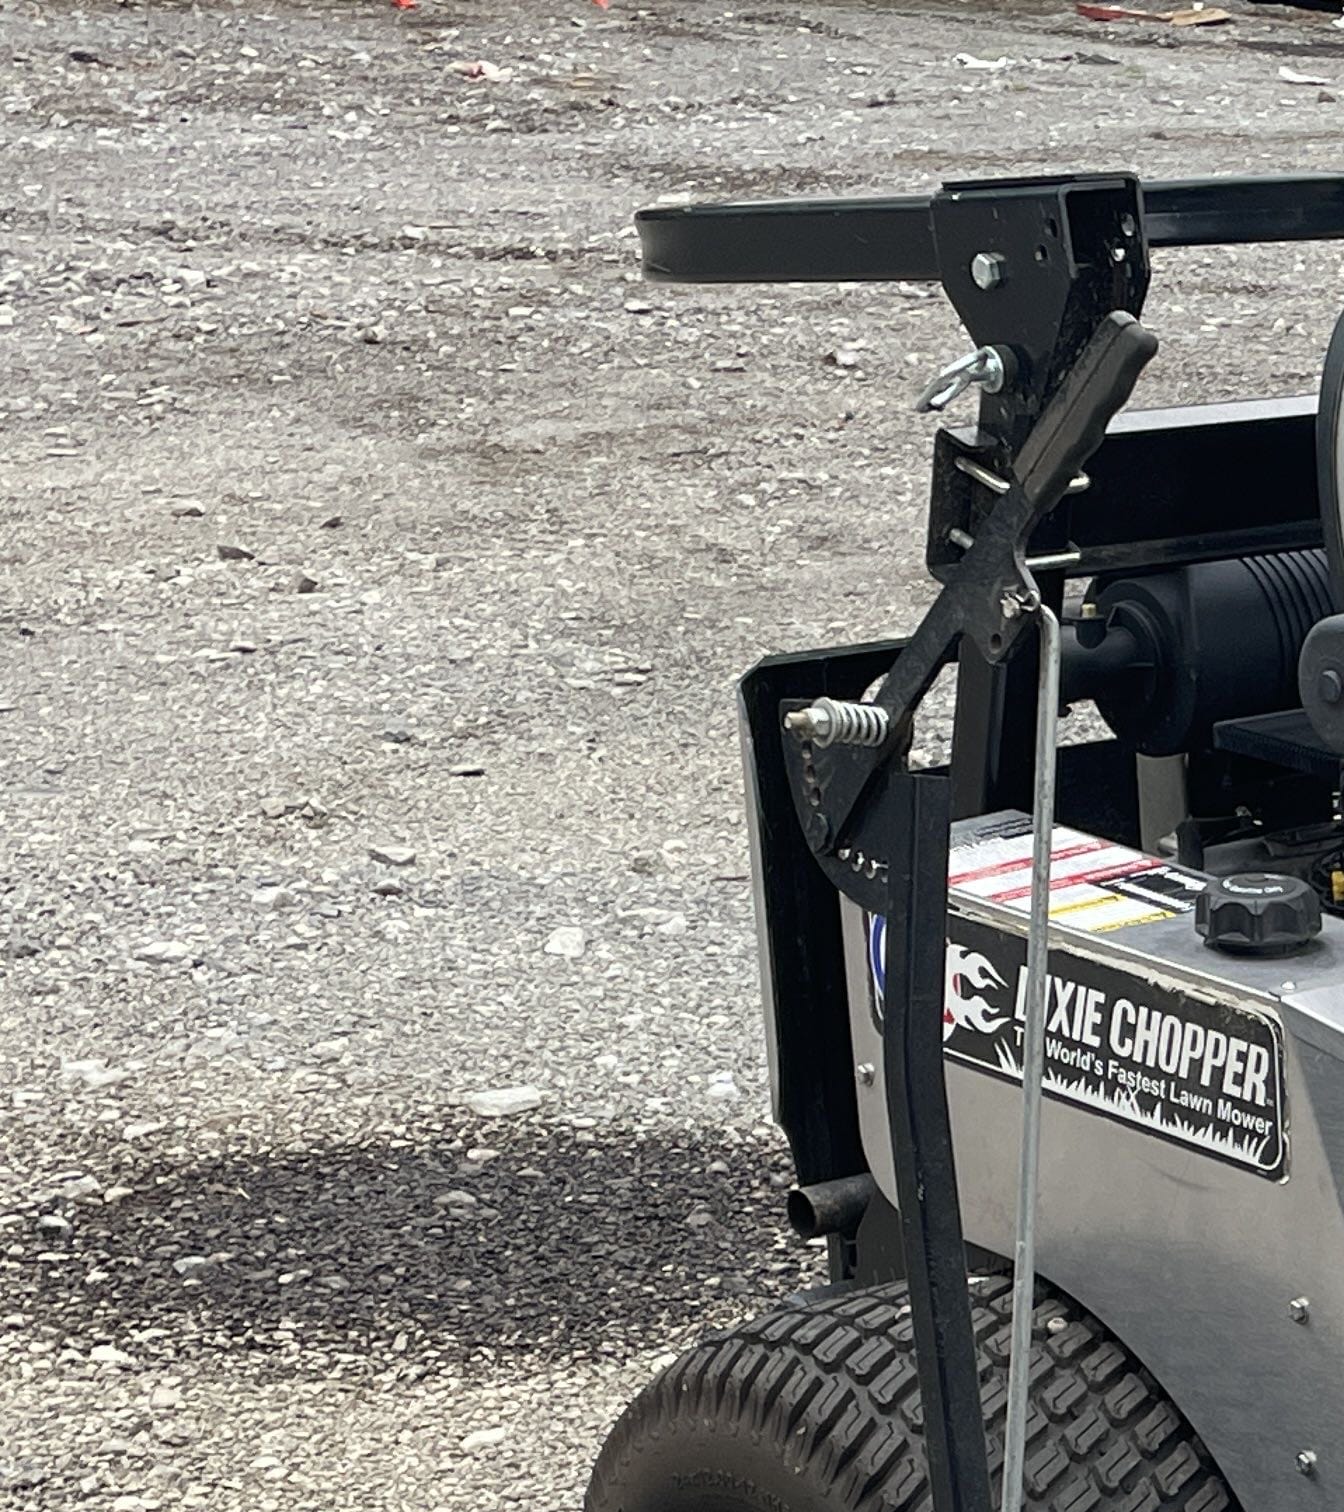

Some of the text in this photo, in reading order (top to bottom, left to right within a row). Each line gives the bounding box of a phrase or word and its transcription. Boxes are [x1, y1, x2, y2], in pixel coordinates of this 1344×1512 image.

[1045, 1037, 1274, 1137] World's Fastest Lawn Mower
[1109, 998, 1270, 1107] CHOPPER
